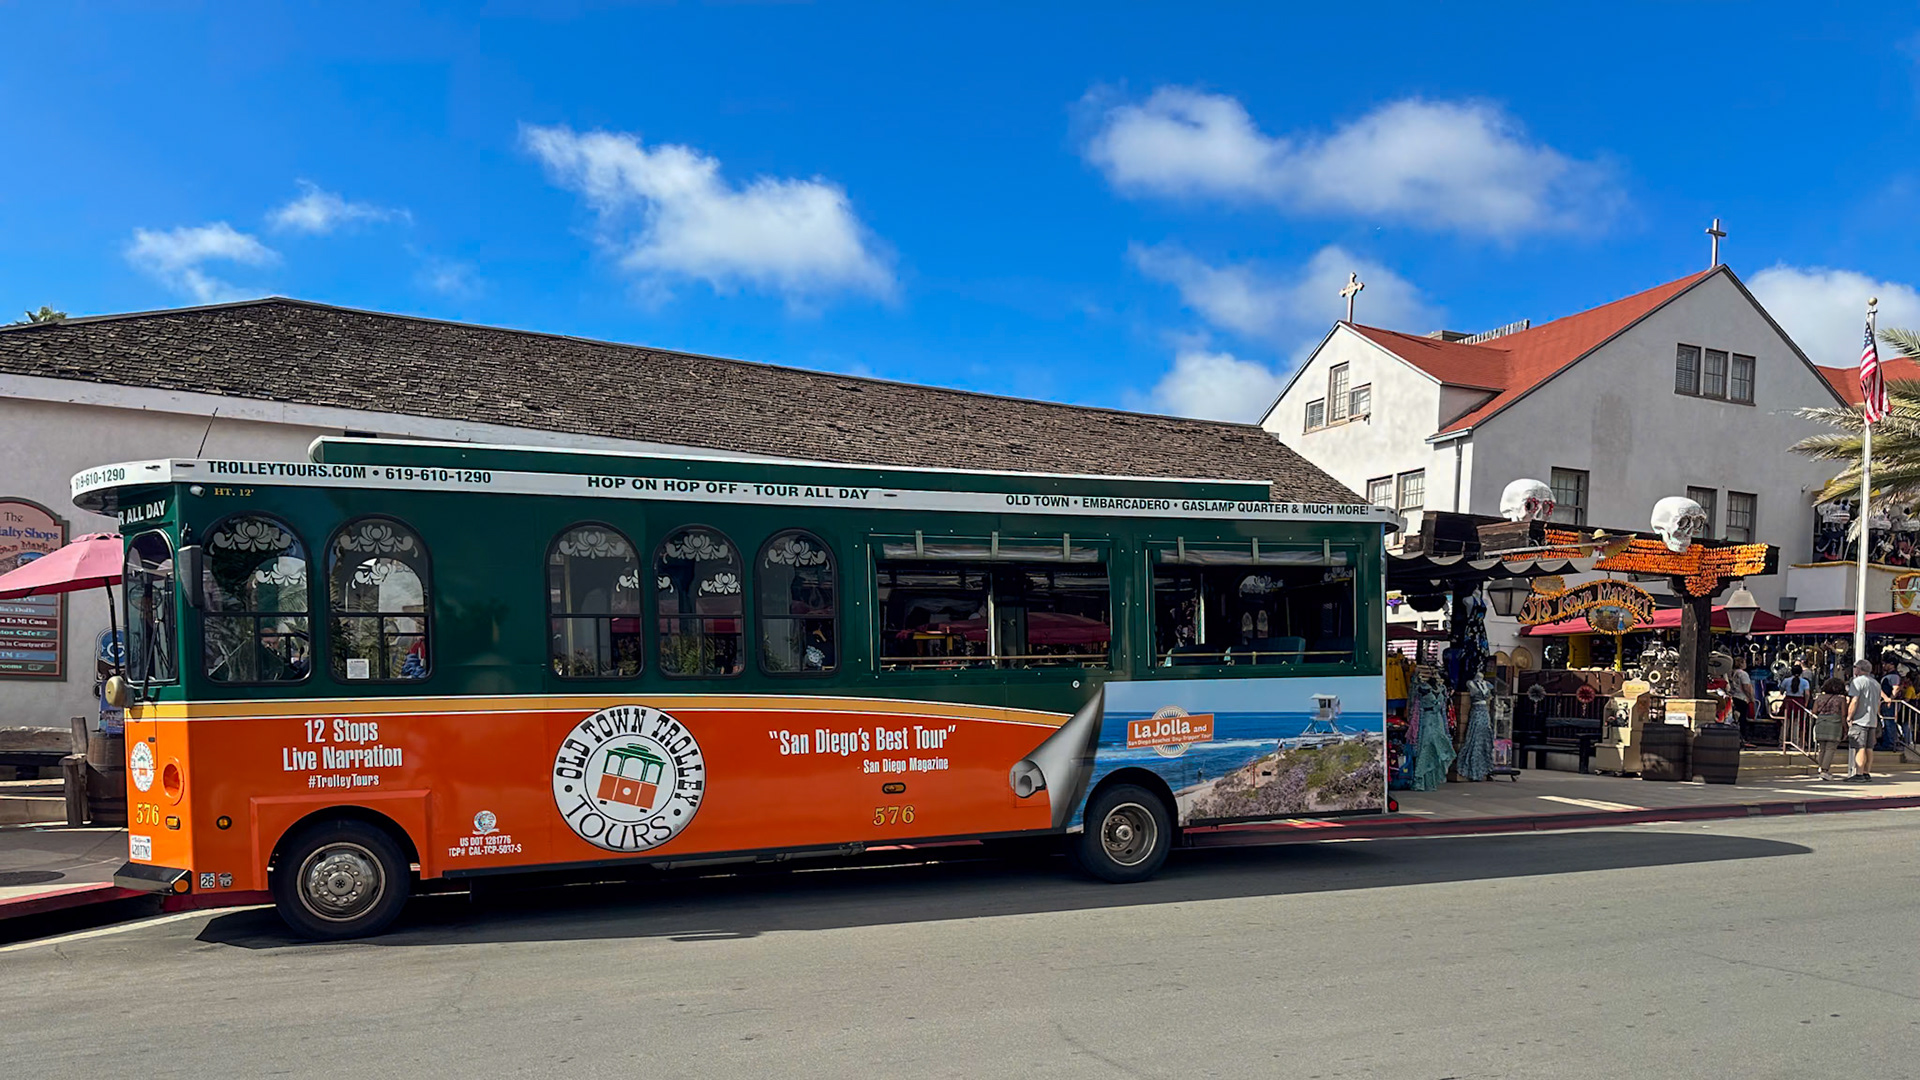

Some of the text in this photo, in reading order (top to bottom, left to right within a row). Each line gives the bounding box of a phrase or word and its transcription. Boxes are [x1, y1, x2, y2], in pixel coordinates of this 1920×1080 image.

[207, 460, 491, 483] TROLLEYTOURS.COM 619-610-1290
[214, 487, 254, 497] HT. 12'
[587, 476, 626, 488] HOP
[631, 478, 657, 490] ON
[663, 480, 700, 492] HOP
[705, 482, 738, 494] OFF
[753, 484, 799, 497] TOUR
[804, 487, 834, 498] ALL
[839, 488, 870, 500] DAY
[126, 506, 144, 524] ALL
[146, 500, 166, 519] DAY
[1005, 494, 1369, 516] OLD TOWN EMBARCADERO GASLAMP QUARTER & MUCH MORE!
[4, 511, 24, 523] The
[24, 527, 59, 542] Shops
[1520, 599, 1552, 621] Old
[1597, 582, 1650, 615] Market
[304, 719, 379, 745] 12 Stops
[1152, 719, 1190, 737] Jolla
[1193, 724, 1207, 733] and
[815, 727, 870, 756] Diego's
[875, 726, 908, 751] Best
[282, 744, 403, 771] Live Narration
[556, 708, 703, 808] OLD TOWN TROLLEY
[863, 758, 880, 773] San
[882, 758, 907, 774] Diego
[909, 756, 949, 773] Magazine
[308, 773, 380, 789] #TrolleyTours
[136, 802, 160, 826] 576
[565, 793, 672, 850] TOURS
[872, 805, 916, 827] 576
[459, 837, 469, 847] US
[470, 836, 484, 846] DOT
[202, 876, 214, 888] 26
